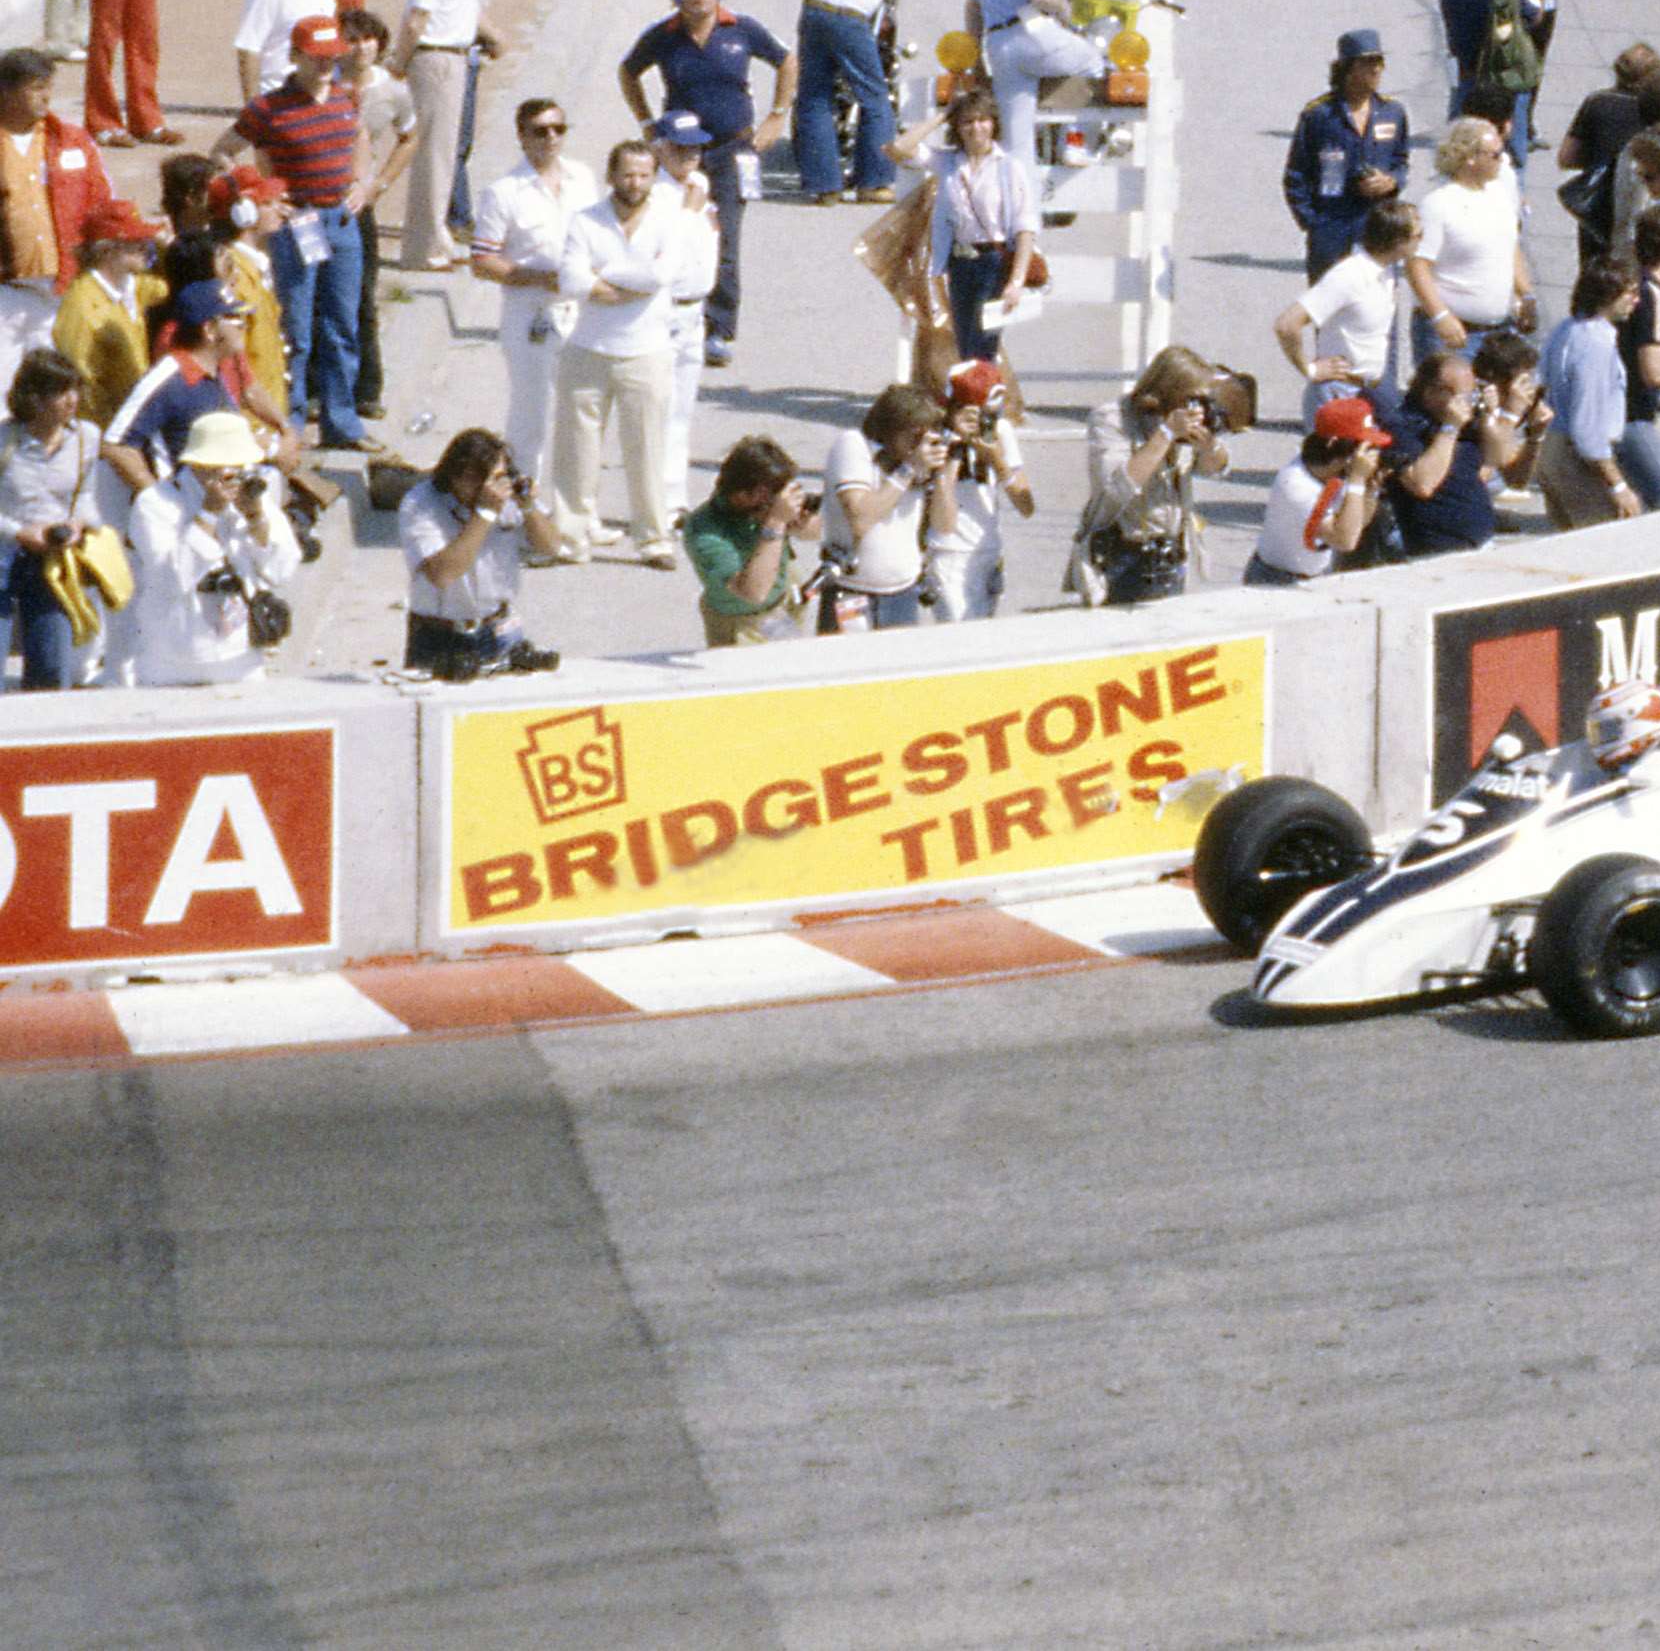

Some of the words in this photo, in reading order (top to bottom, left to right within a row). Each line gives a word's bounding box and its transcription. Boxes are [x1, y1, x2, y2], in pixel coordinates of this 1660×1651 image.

[459, 644, 1228, 922] BRIDGESTONE
[537, 743, 613, 807] BS
[880, 739, 1188, 884] TIRES
[0, 773, 304, 930] TA
